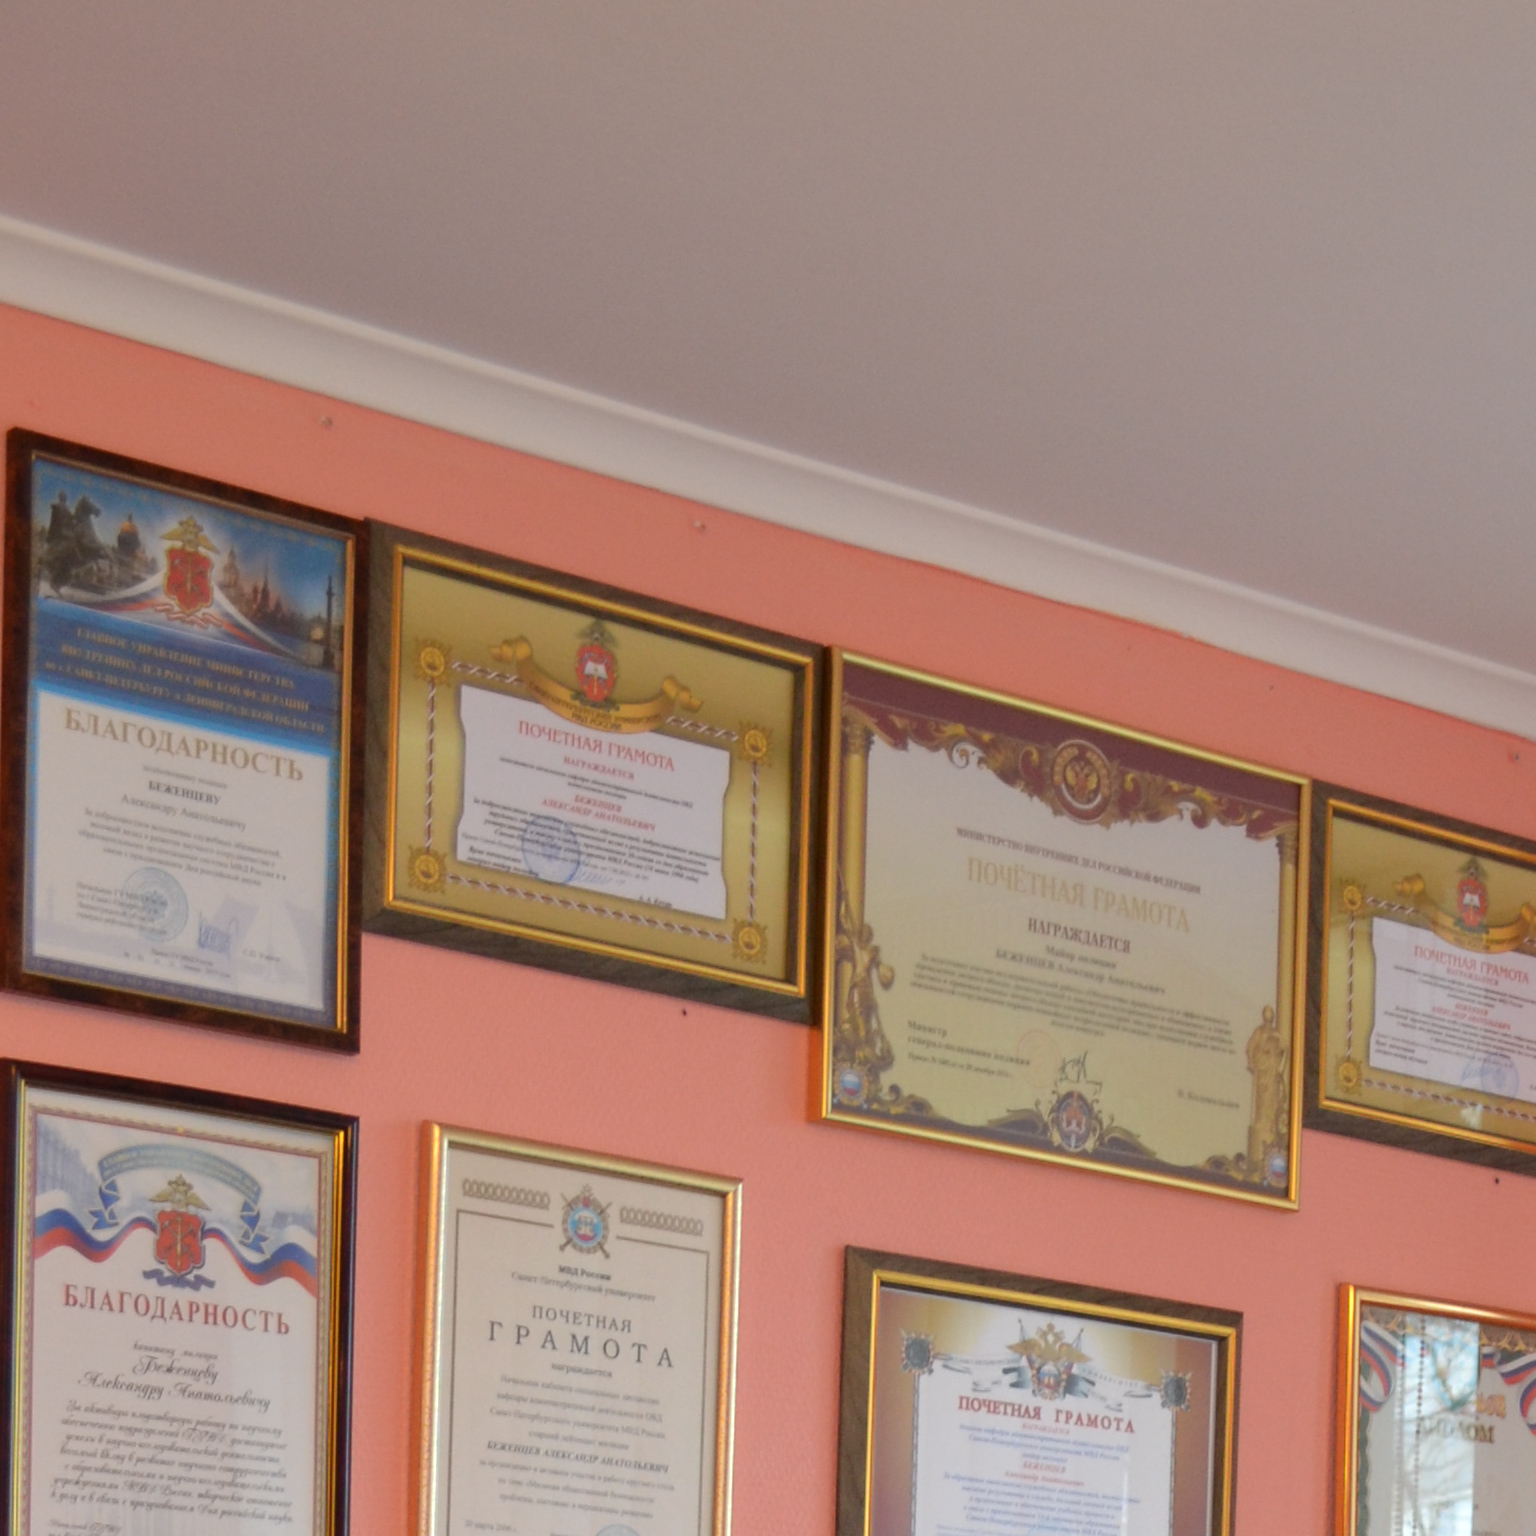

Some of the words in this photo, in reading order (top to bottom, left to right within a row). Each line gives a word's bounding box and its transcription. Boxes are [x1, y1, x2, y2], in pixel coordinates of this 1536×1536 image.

[65, 707, 304, 785] БЛАГОДАРНОСТЬ
[518, 719, 601, 754] ПОЧЕТНАЯ
[608, 741, 674, 772] ГРАМОТА
[563, 755, 634, 781] НАГРАЖДАЕТСЯ
[149, 780, 221, 807] БЕЖЕНЦЕВУ
[967, 852, 1085, 909] ПОЧЁТНАЯ
[1092, 883, 1191, 934] ГРАМОТА
[1028, 916, 1130, 955] НАГРАЖДАЕТСЯ
[1415, 944, 1476, 972] ПОЧЕТНАЯ
[1480, 960, 1529, 985] ГРАМОТА
[63, 1283, 290, 1338] БЛАГОДАРНОСТЬ
[531, 1304, 632, 1334] ПОЧЕТНАЯ
[488, 1319, 674, 1368] ГРАМОТА
[958, 1395, 1042, 1421] ПОЧЕТНАЯ
[1054, 1408, 1135, 1433] ГРАМОТА
